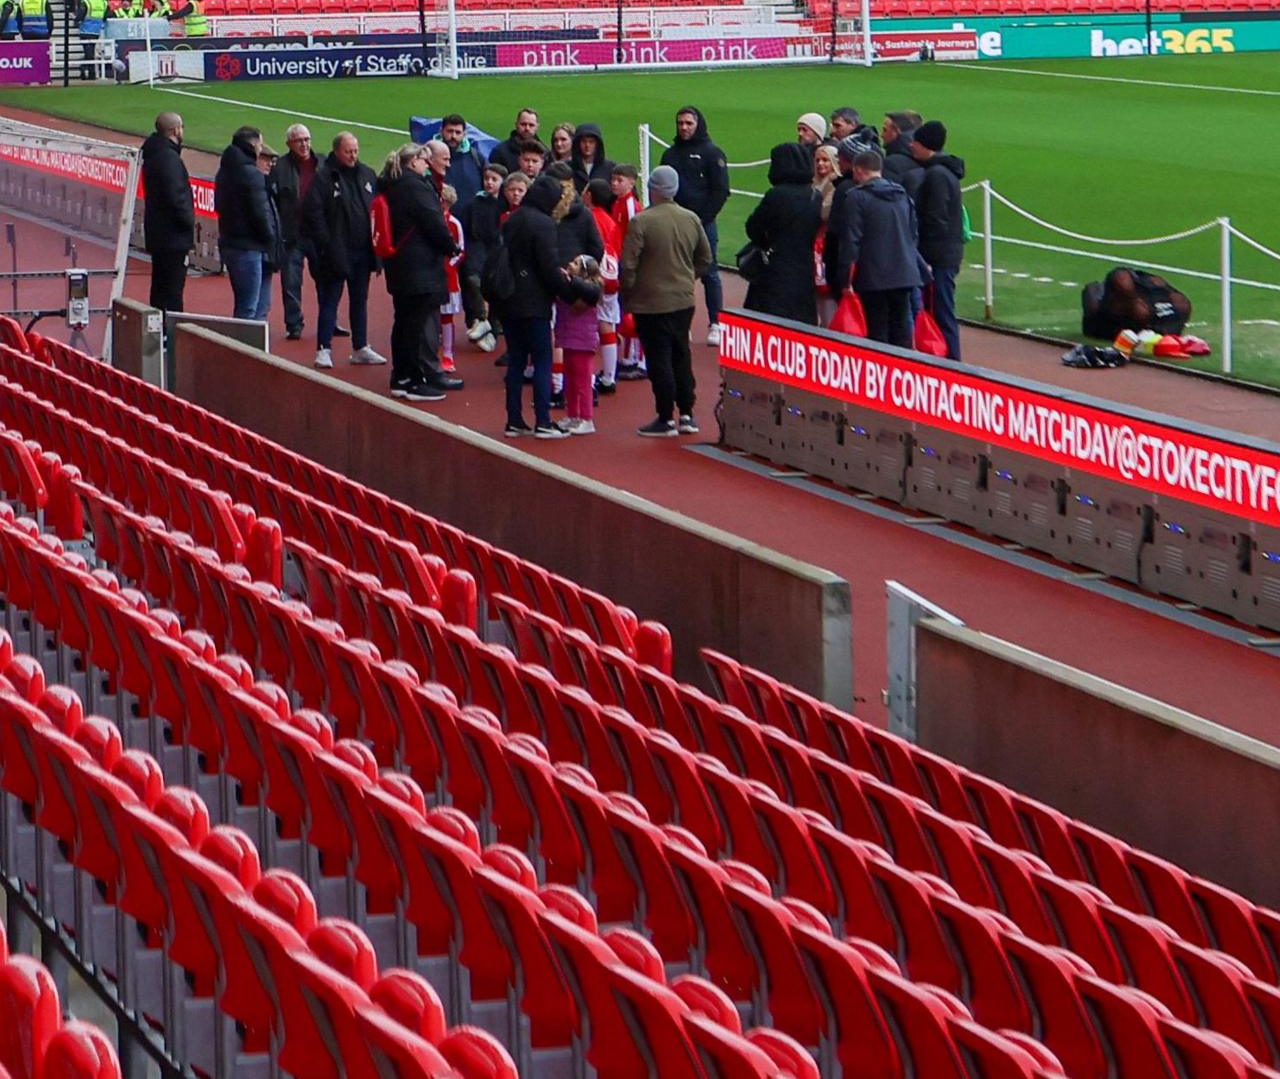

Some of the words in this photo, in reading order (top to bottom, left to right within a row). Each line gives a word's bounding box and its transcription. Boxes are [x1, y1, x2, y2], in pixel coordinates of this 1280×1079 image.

[523, 45, 581, 66] pink
[701, 39, 758, 61] pink
[246, 57, 339, 78] University
[753, 331, 766, 368] A
[767, 334, 807, 379] CLUB
[809, 346, 862, 395] TODAY
[865, 360, 888, 402] BY
[890, 368, 1005, 436] CONTACTING
